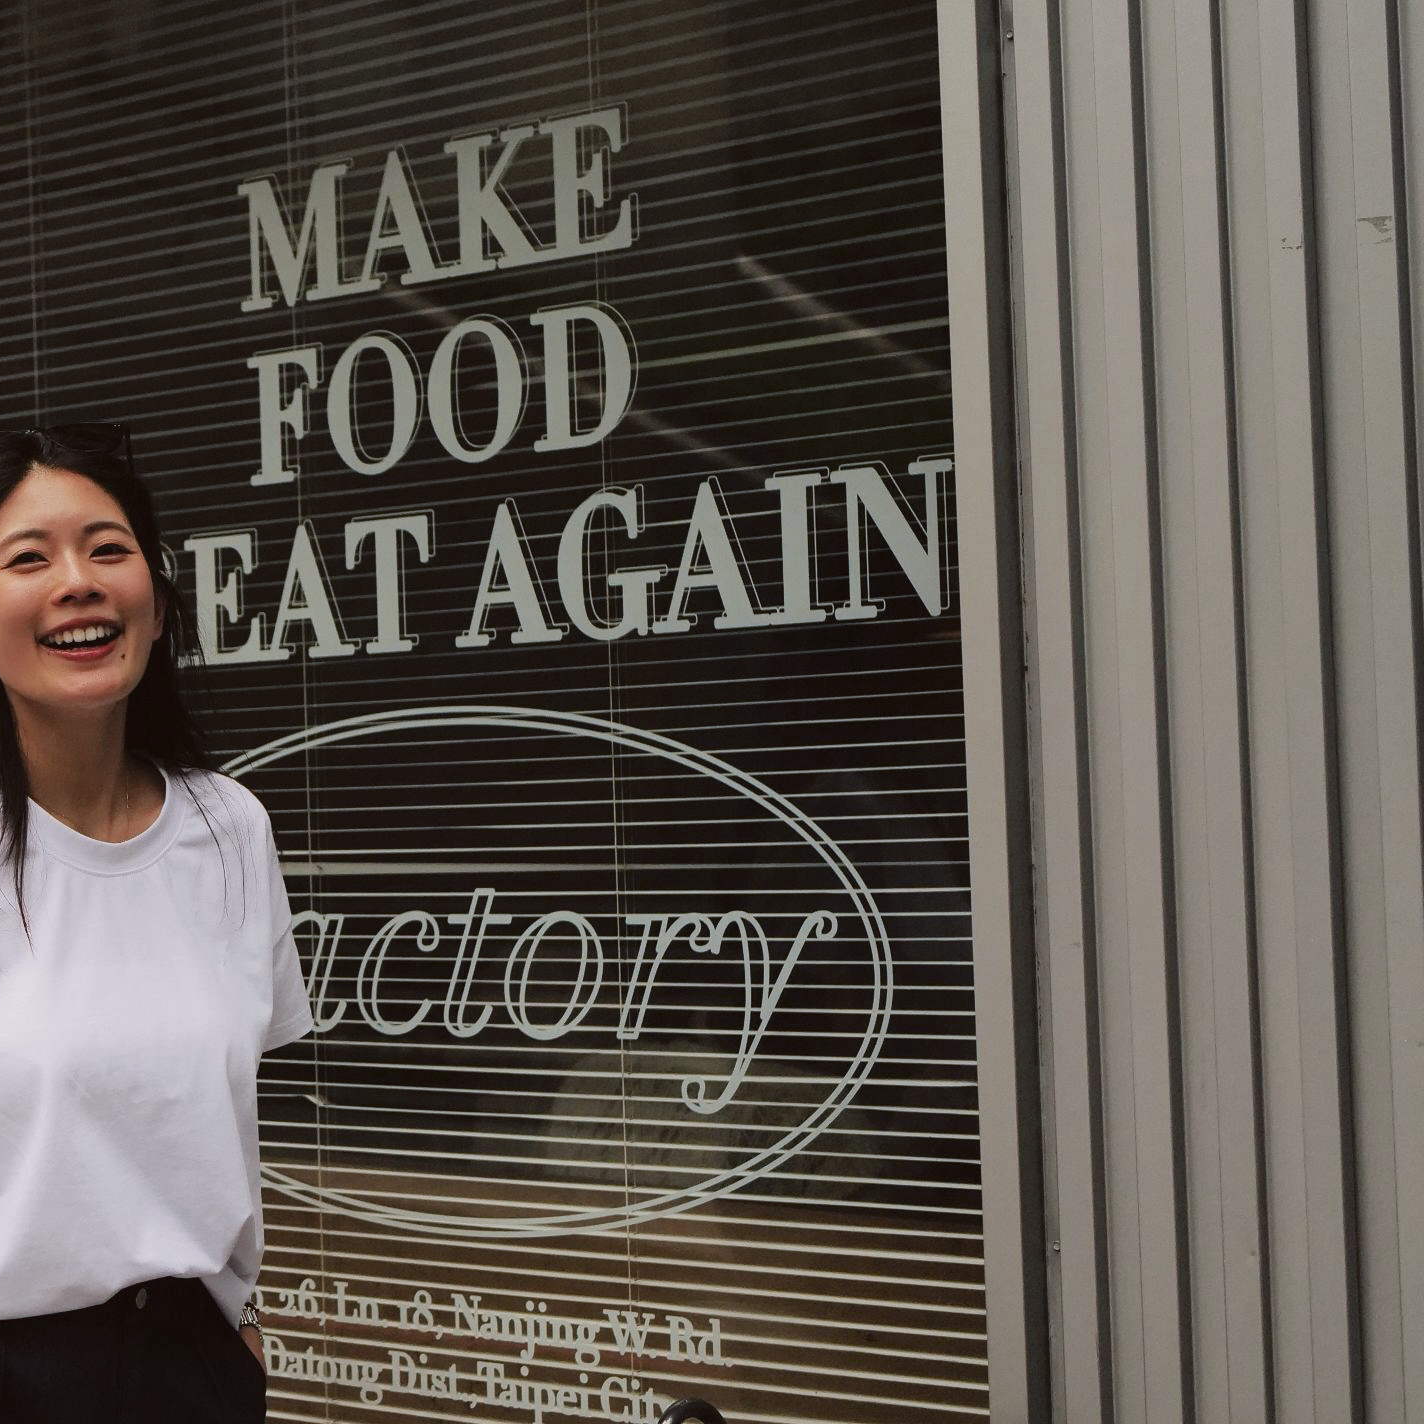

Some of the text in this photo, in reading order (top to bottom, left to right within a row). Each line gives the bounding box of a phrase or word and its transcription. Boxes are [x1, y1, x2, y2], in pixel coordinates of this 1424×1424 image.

[238, 102, 639, 313] MAKE
[247, 301, 639, 487] FOOD
[160, 452, 955, 667] EAT AGAIN
[291, 888, 838, 1114] actory
[263, 1334, 384, 1405] Datong
[279, 1278, 326, 1326] 26,
[333, 1281, 388, 1328] Ln.
[397, 1289, 444, 1340] 18,
[451, 1293, 601, 1368] Nanjing
[602, 1308, 658, 1360] W.
[665, 1315, 737, 1367] Rd.
